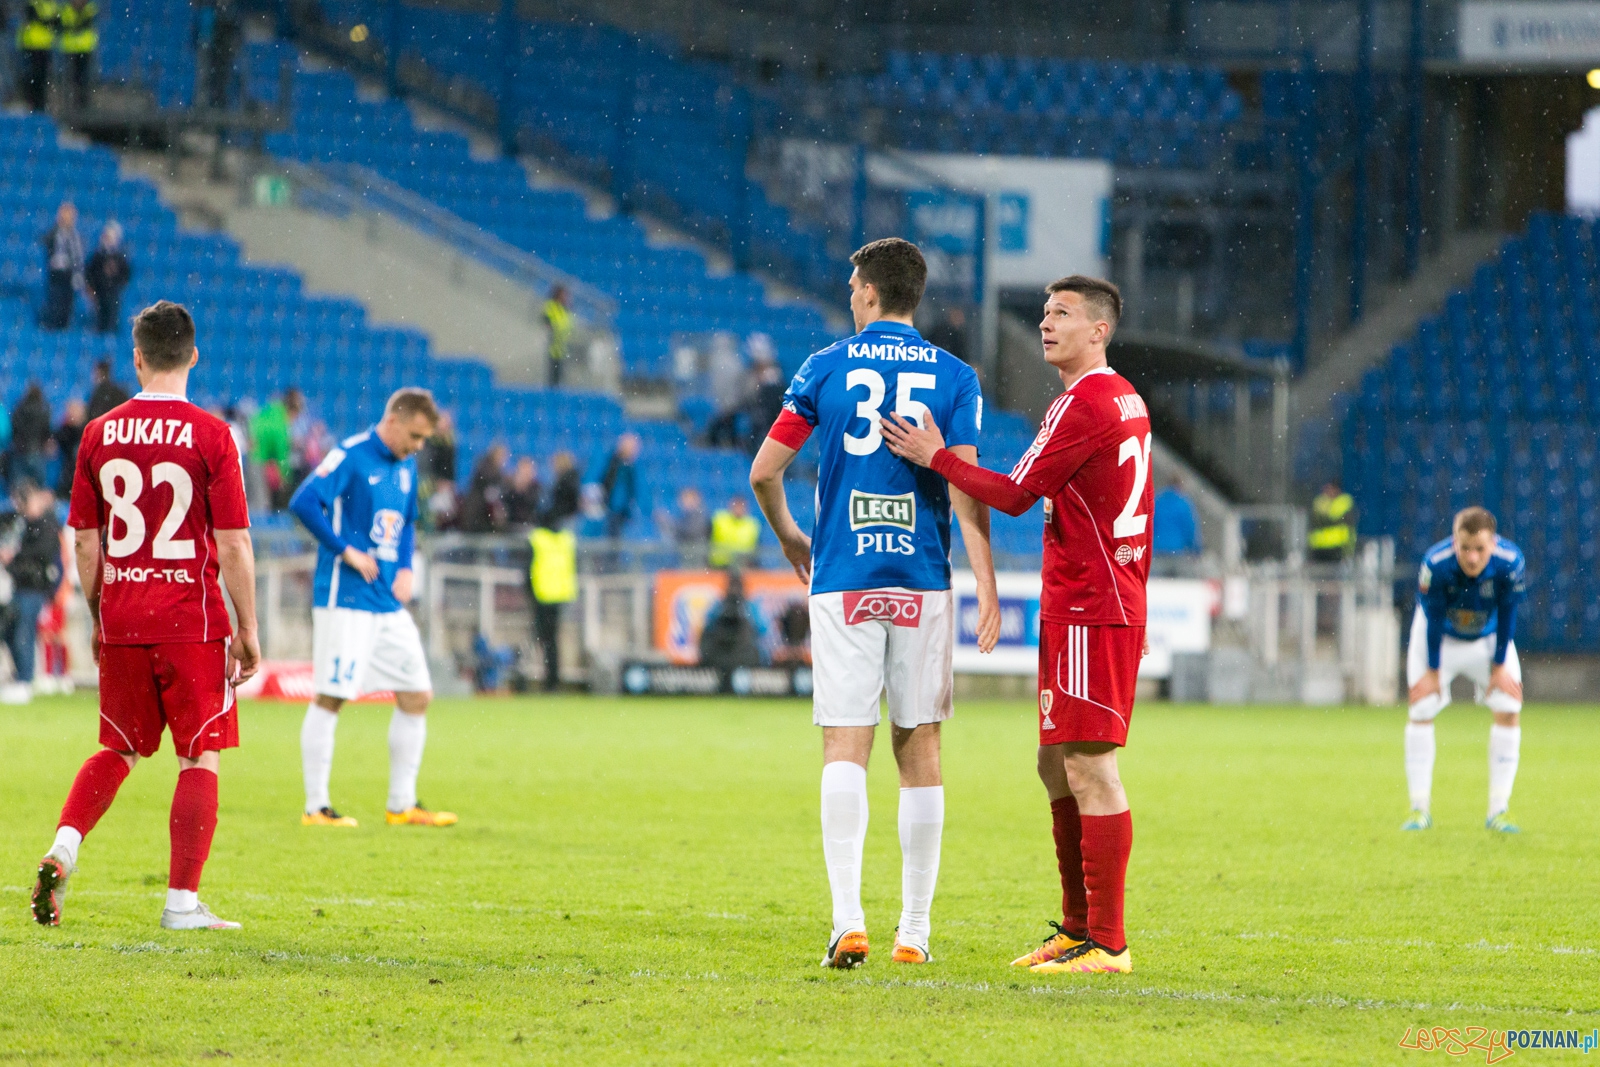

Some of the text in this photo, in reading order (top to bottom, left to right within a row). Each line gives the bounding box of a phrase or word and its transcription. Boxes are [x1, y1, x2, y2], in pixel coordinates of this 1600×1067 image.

[848, 342, 937, 363] KAMIŃSKI
[843, 368, 937, 456] 35
[103, 418, 193, 449] BUKATA
[1113, 431, 1152, 538] 2
[99, 458, 196, 559] 82
[856, 500, 909, 521] LECH
[854, 533, 915, 556] PILS
[330, 657, 356, 683] 14
